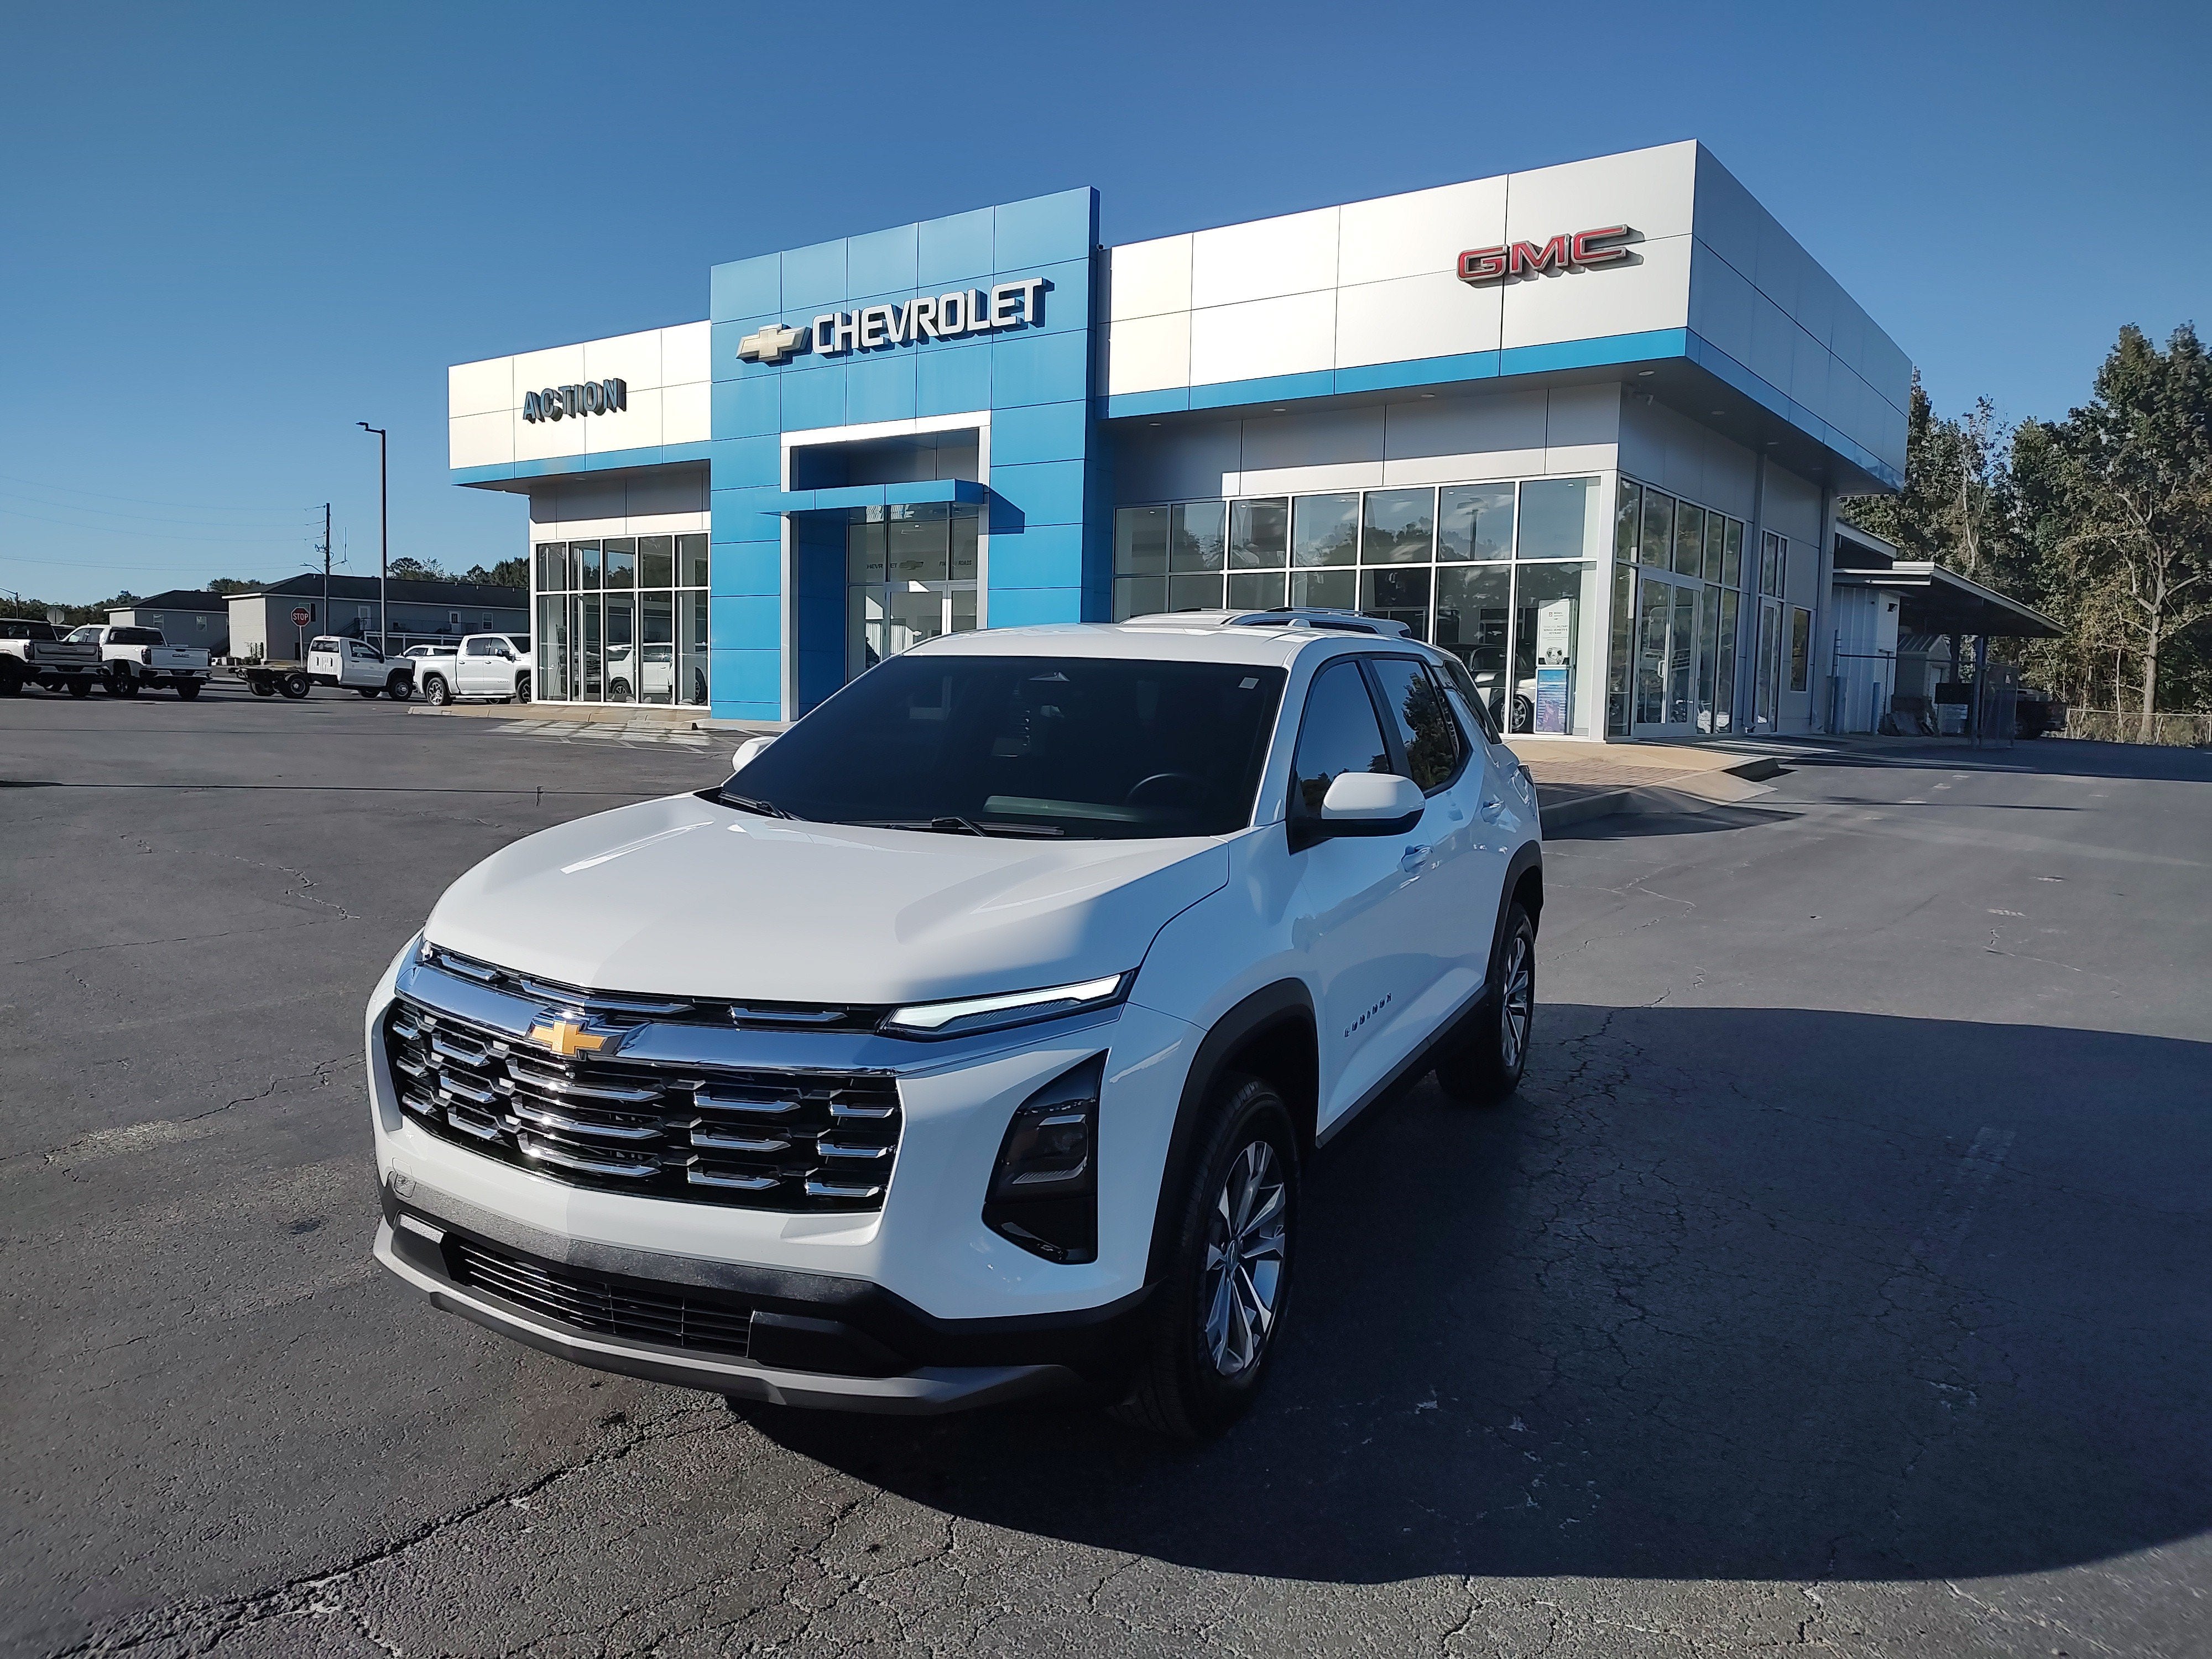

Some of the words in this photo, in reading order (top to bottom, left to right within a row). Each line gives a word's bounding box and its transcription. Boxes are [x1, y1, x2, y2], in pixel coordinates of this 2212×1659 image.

[1457, 225, 1627, 282] GMC
[812, 277, 1044, 354] CHEVROLET
[523, 378, 624, 422] ACTION
[1344, 992, 1392, 1038] EQUINOX
